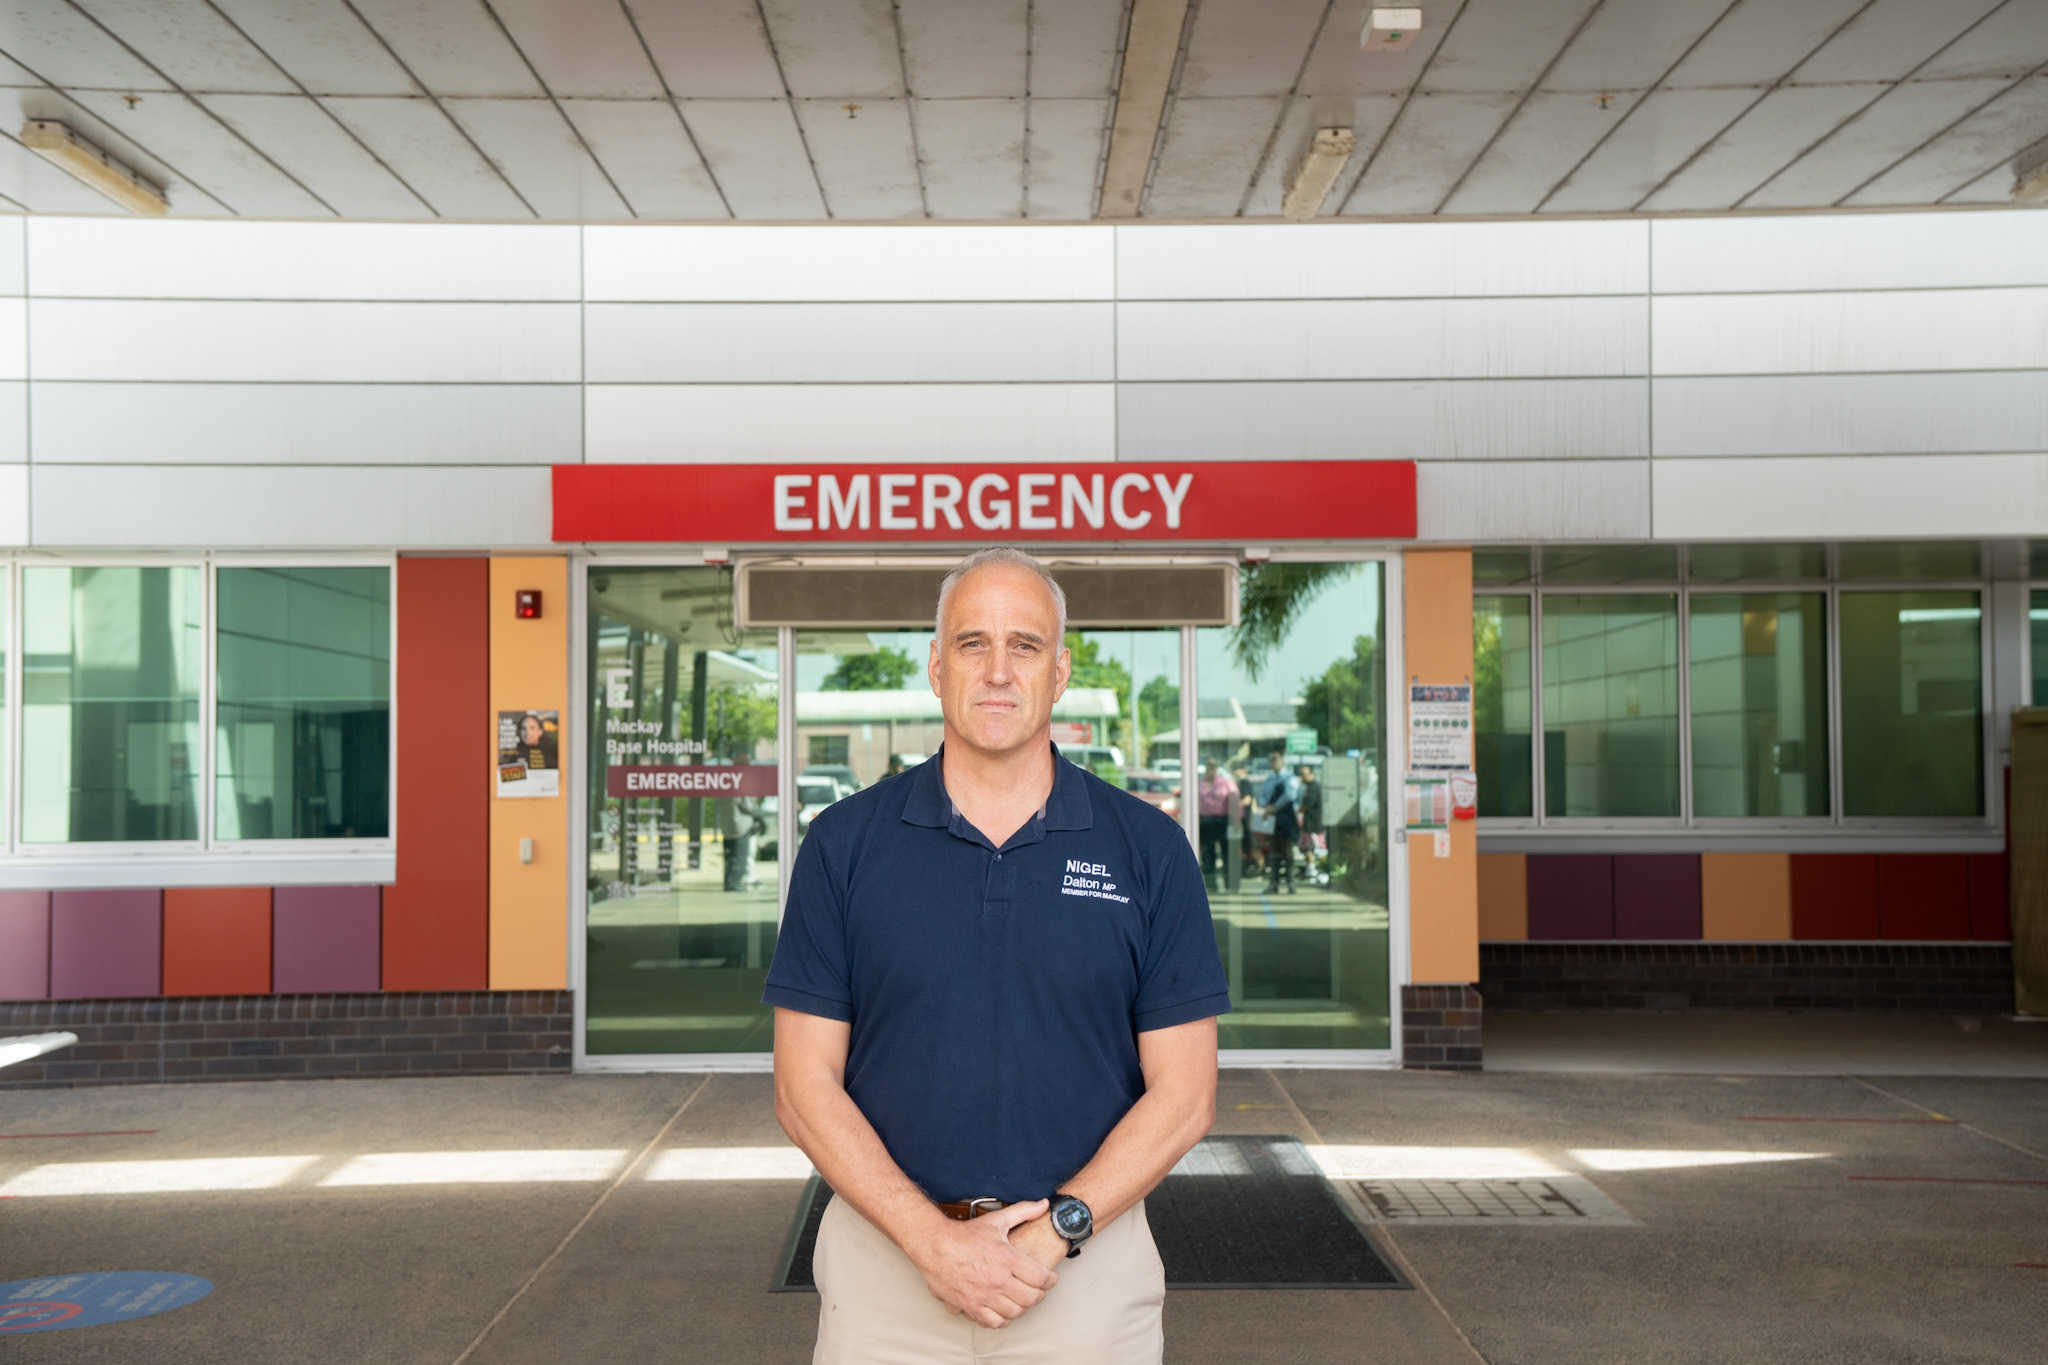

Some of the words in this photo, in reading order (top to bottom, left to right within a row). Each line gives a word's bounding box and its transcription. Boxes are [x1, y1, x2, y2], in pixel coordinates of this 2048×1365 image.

[773, 472, 1194, 531] EMERGENCY
[606, 668, 634, 708] E
[606, 719, 663, 736] Mackay
[606, 739, 642, 754] Base
[647, 738, 707, 756] Hospital
[626, 772, 743, 790] EMERGENCY
[1065, 859, 1111, 877] NIGEL
[1062, 874, 1100, 889] Dalton
[1101, 882, 1116, 891] MP
[1061, 887, 1088, 897] MEMBER
[1088, 890, 1102, 898] FOR
[1102, 892, 1130, 904] MACKAY
